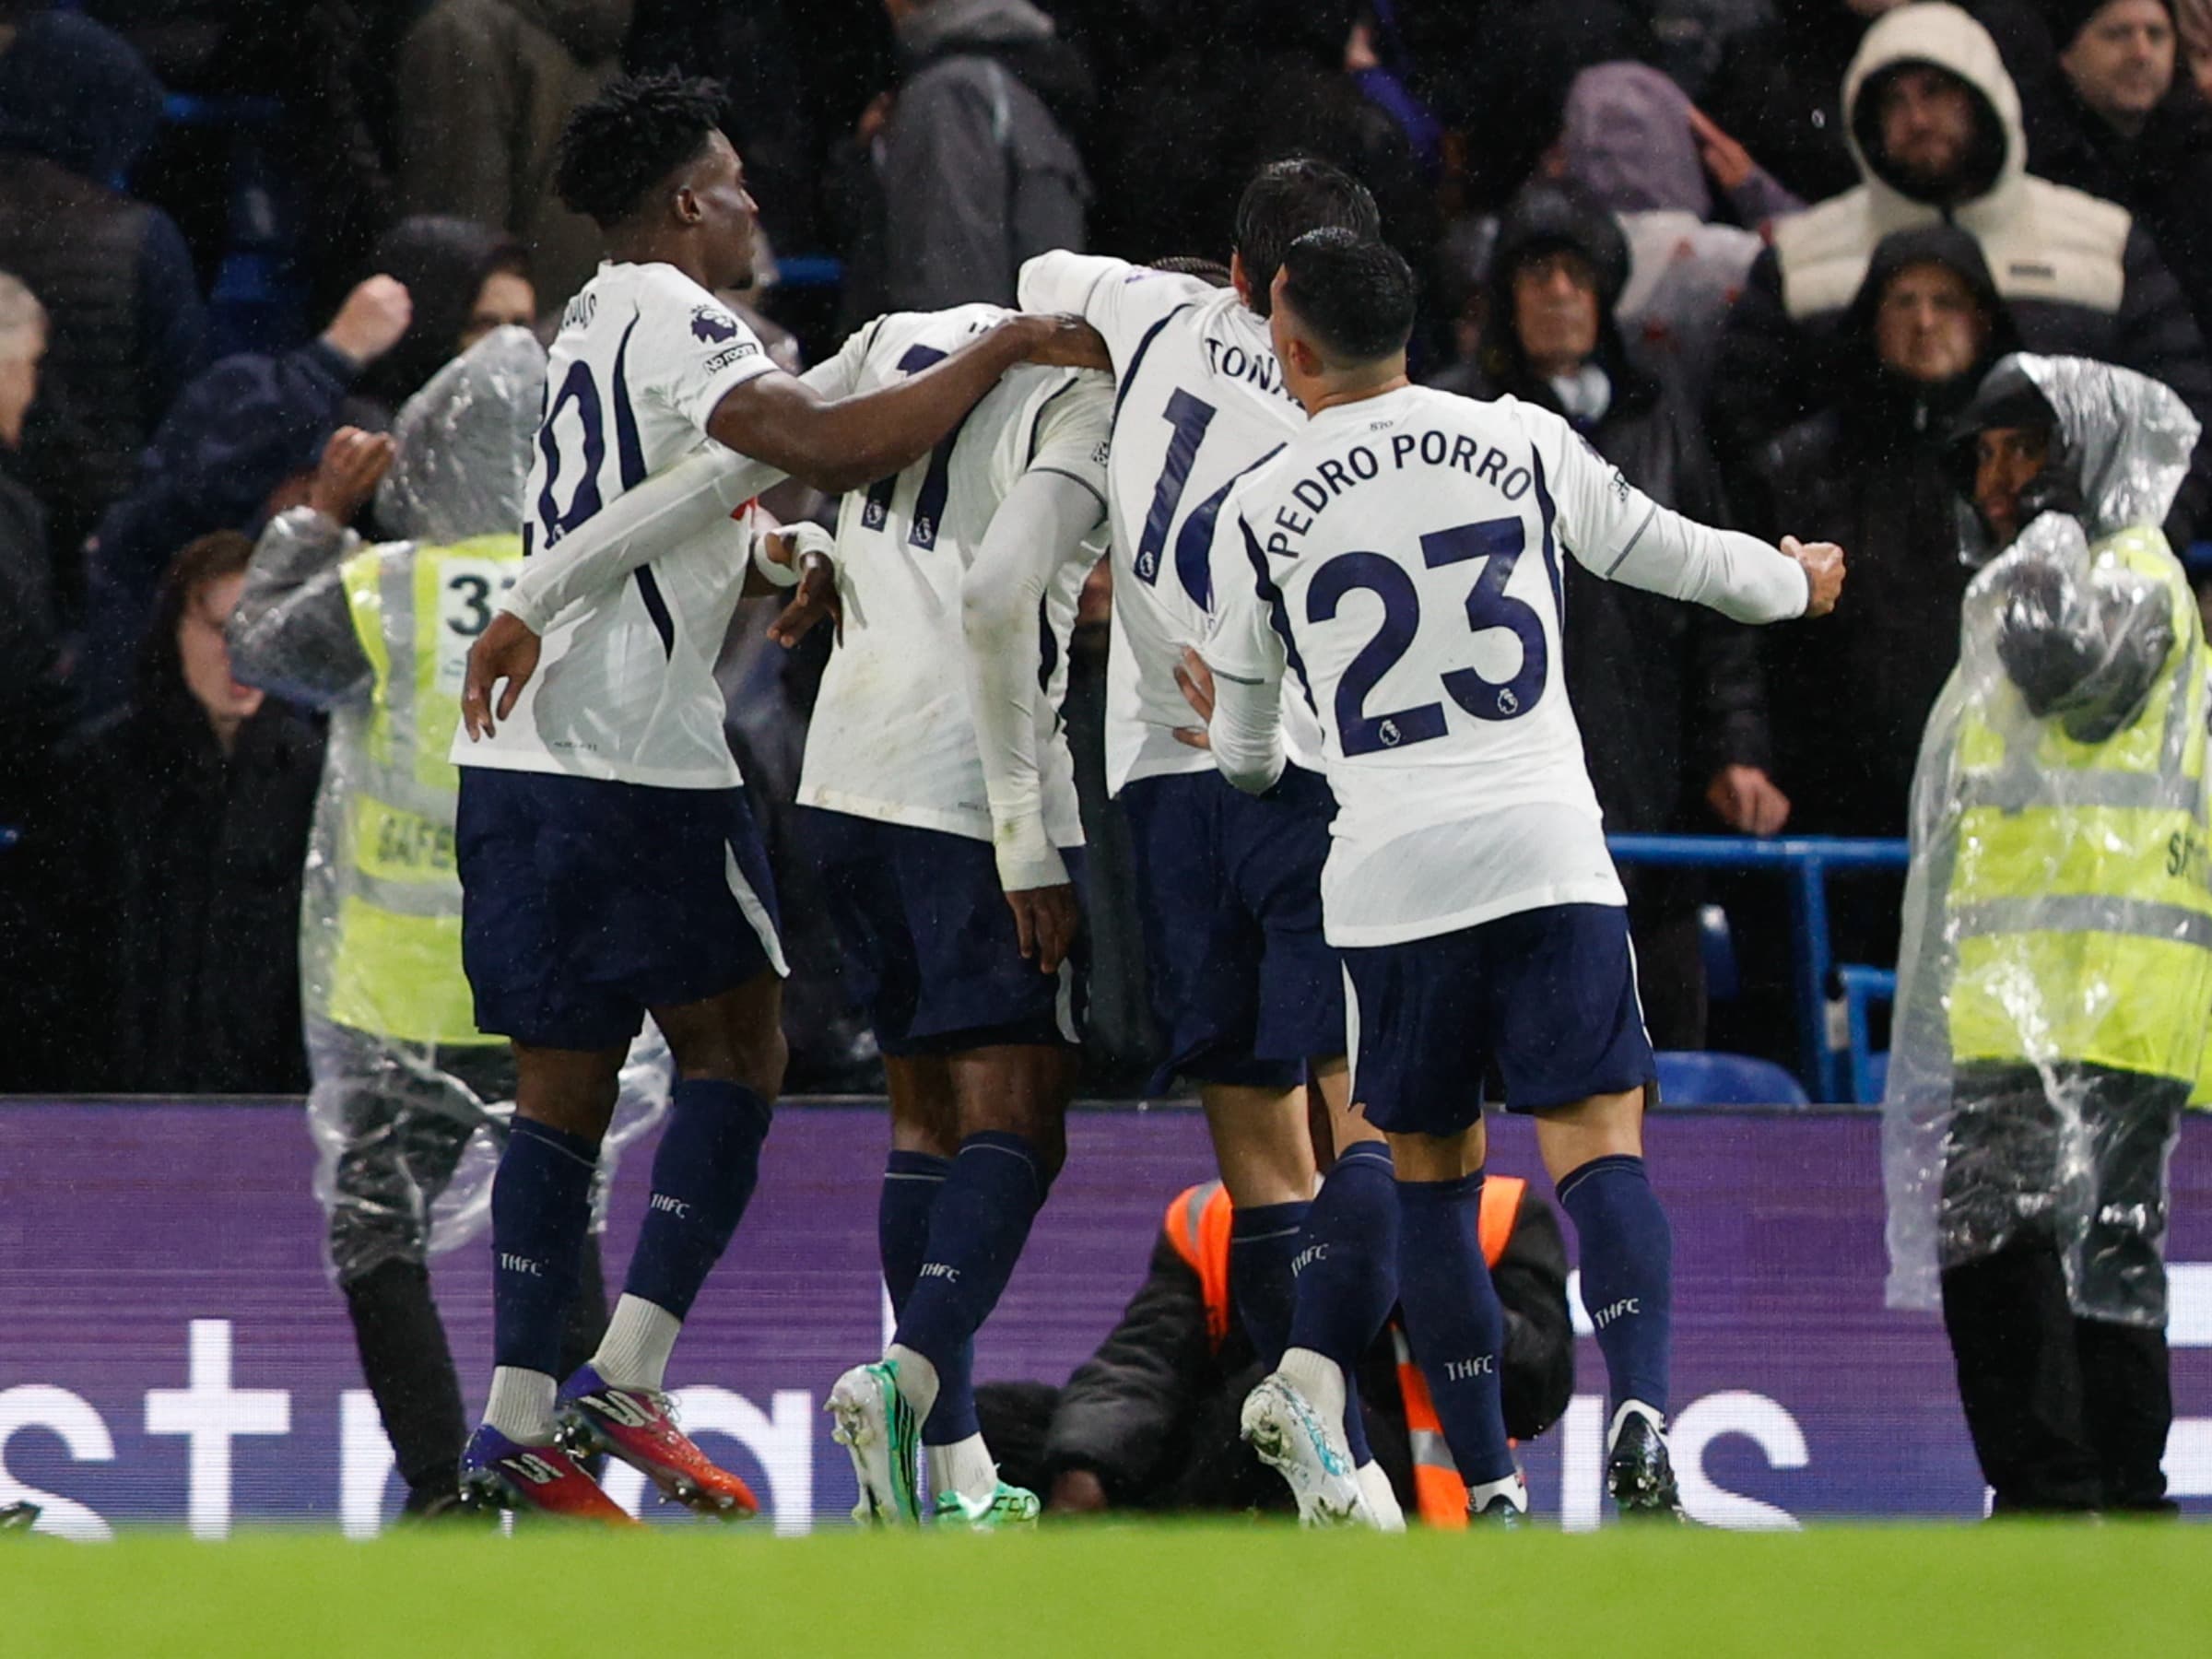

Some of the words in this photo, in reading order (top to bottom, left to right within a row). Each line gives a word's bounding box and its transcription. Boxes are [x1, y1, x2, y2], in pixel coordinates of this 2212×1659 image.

[521, 360, 606, 556] 0
[1266, 445, 1380, 559] PEDRO
[1393, 429, 1533, 502] PORRO
[447, 574, 516, 636] 3
[1306, 515, 1549, 758] 23
[651, 1194, 690, 1218] THFC
[500, 1253, 543, 1277] THFC
[919, 1263, 960, 1283] THFC
[1594, 1298, 1640, 1329] THFC
[1444, 1355, 1493, 1382] THFC
